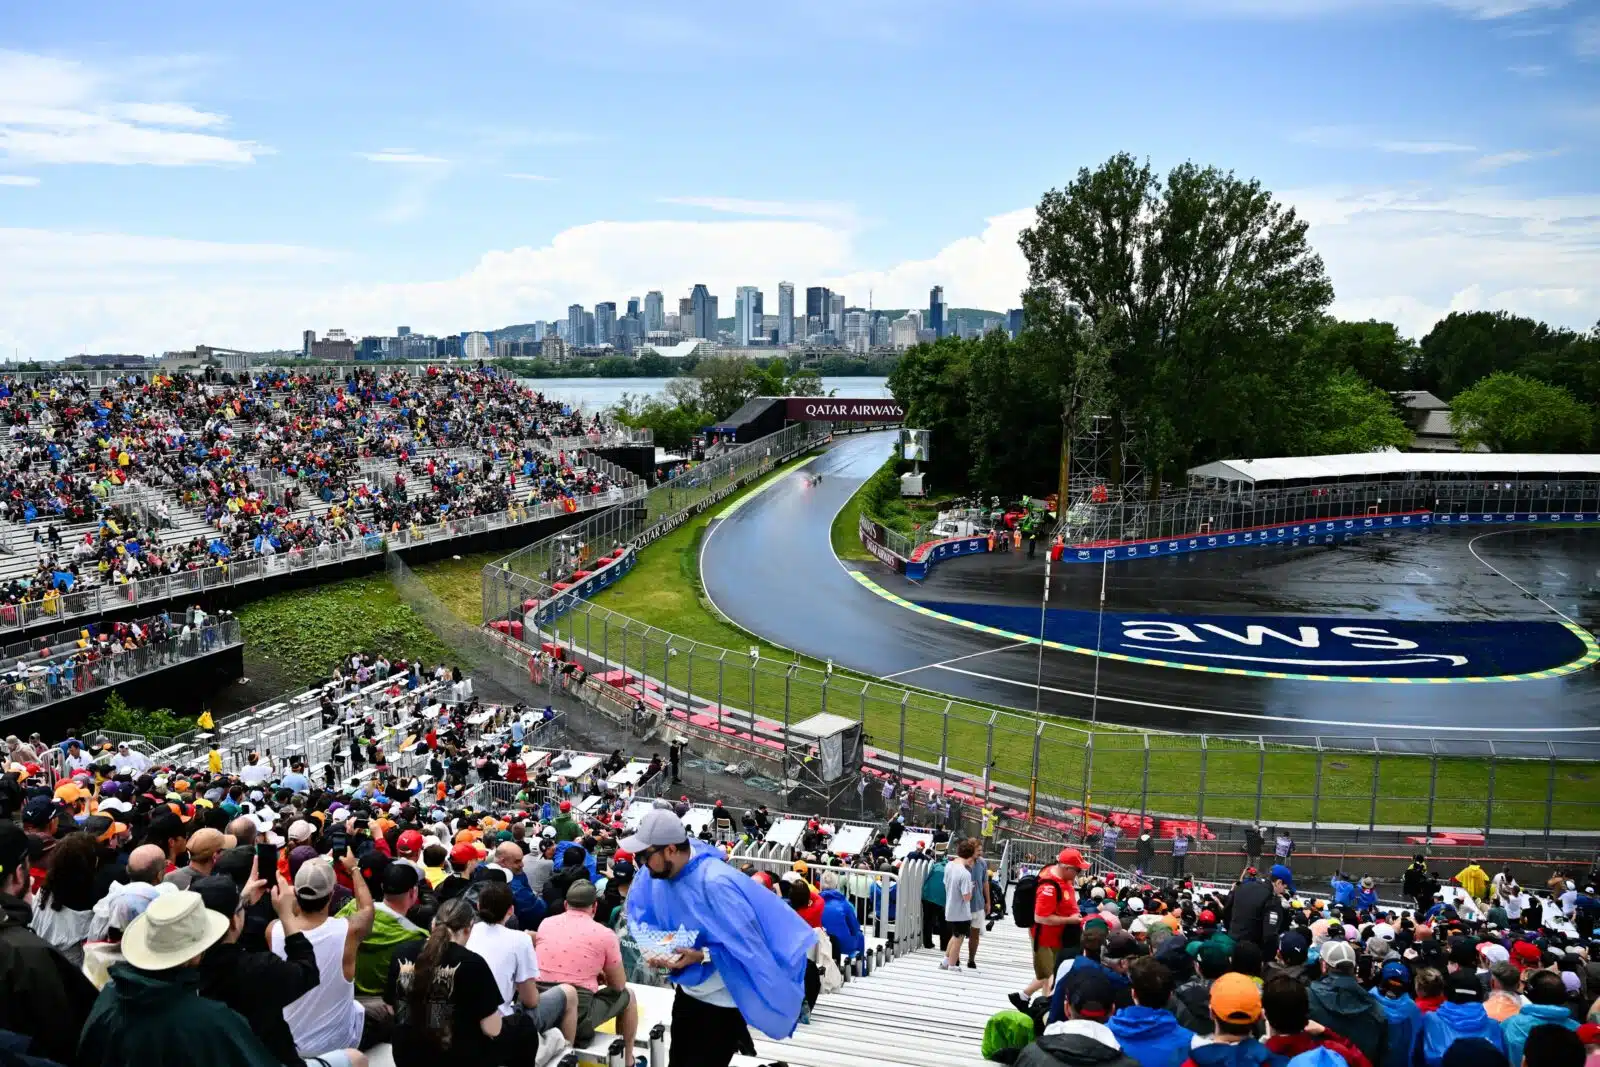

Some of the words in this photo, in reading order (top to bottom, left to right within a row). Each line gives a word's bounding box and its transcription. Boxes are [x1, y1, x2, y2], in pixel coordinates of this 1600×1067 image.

[805, 404, 847, 416] QATAR
[850, 404, 904, 416] AIRWAYS
[696, 494, 716, 513] QATAR
[634, 526, 661, 550] QATAR
[661, 510, 690, 535] AIRWAYS
[1120, 621, 1419, 651] aws
